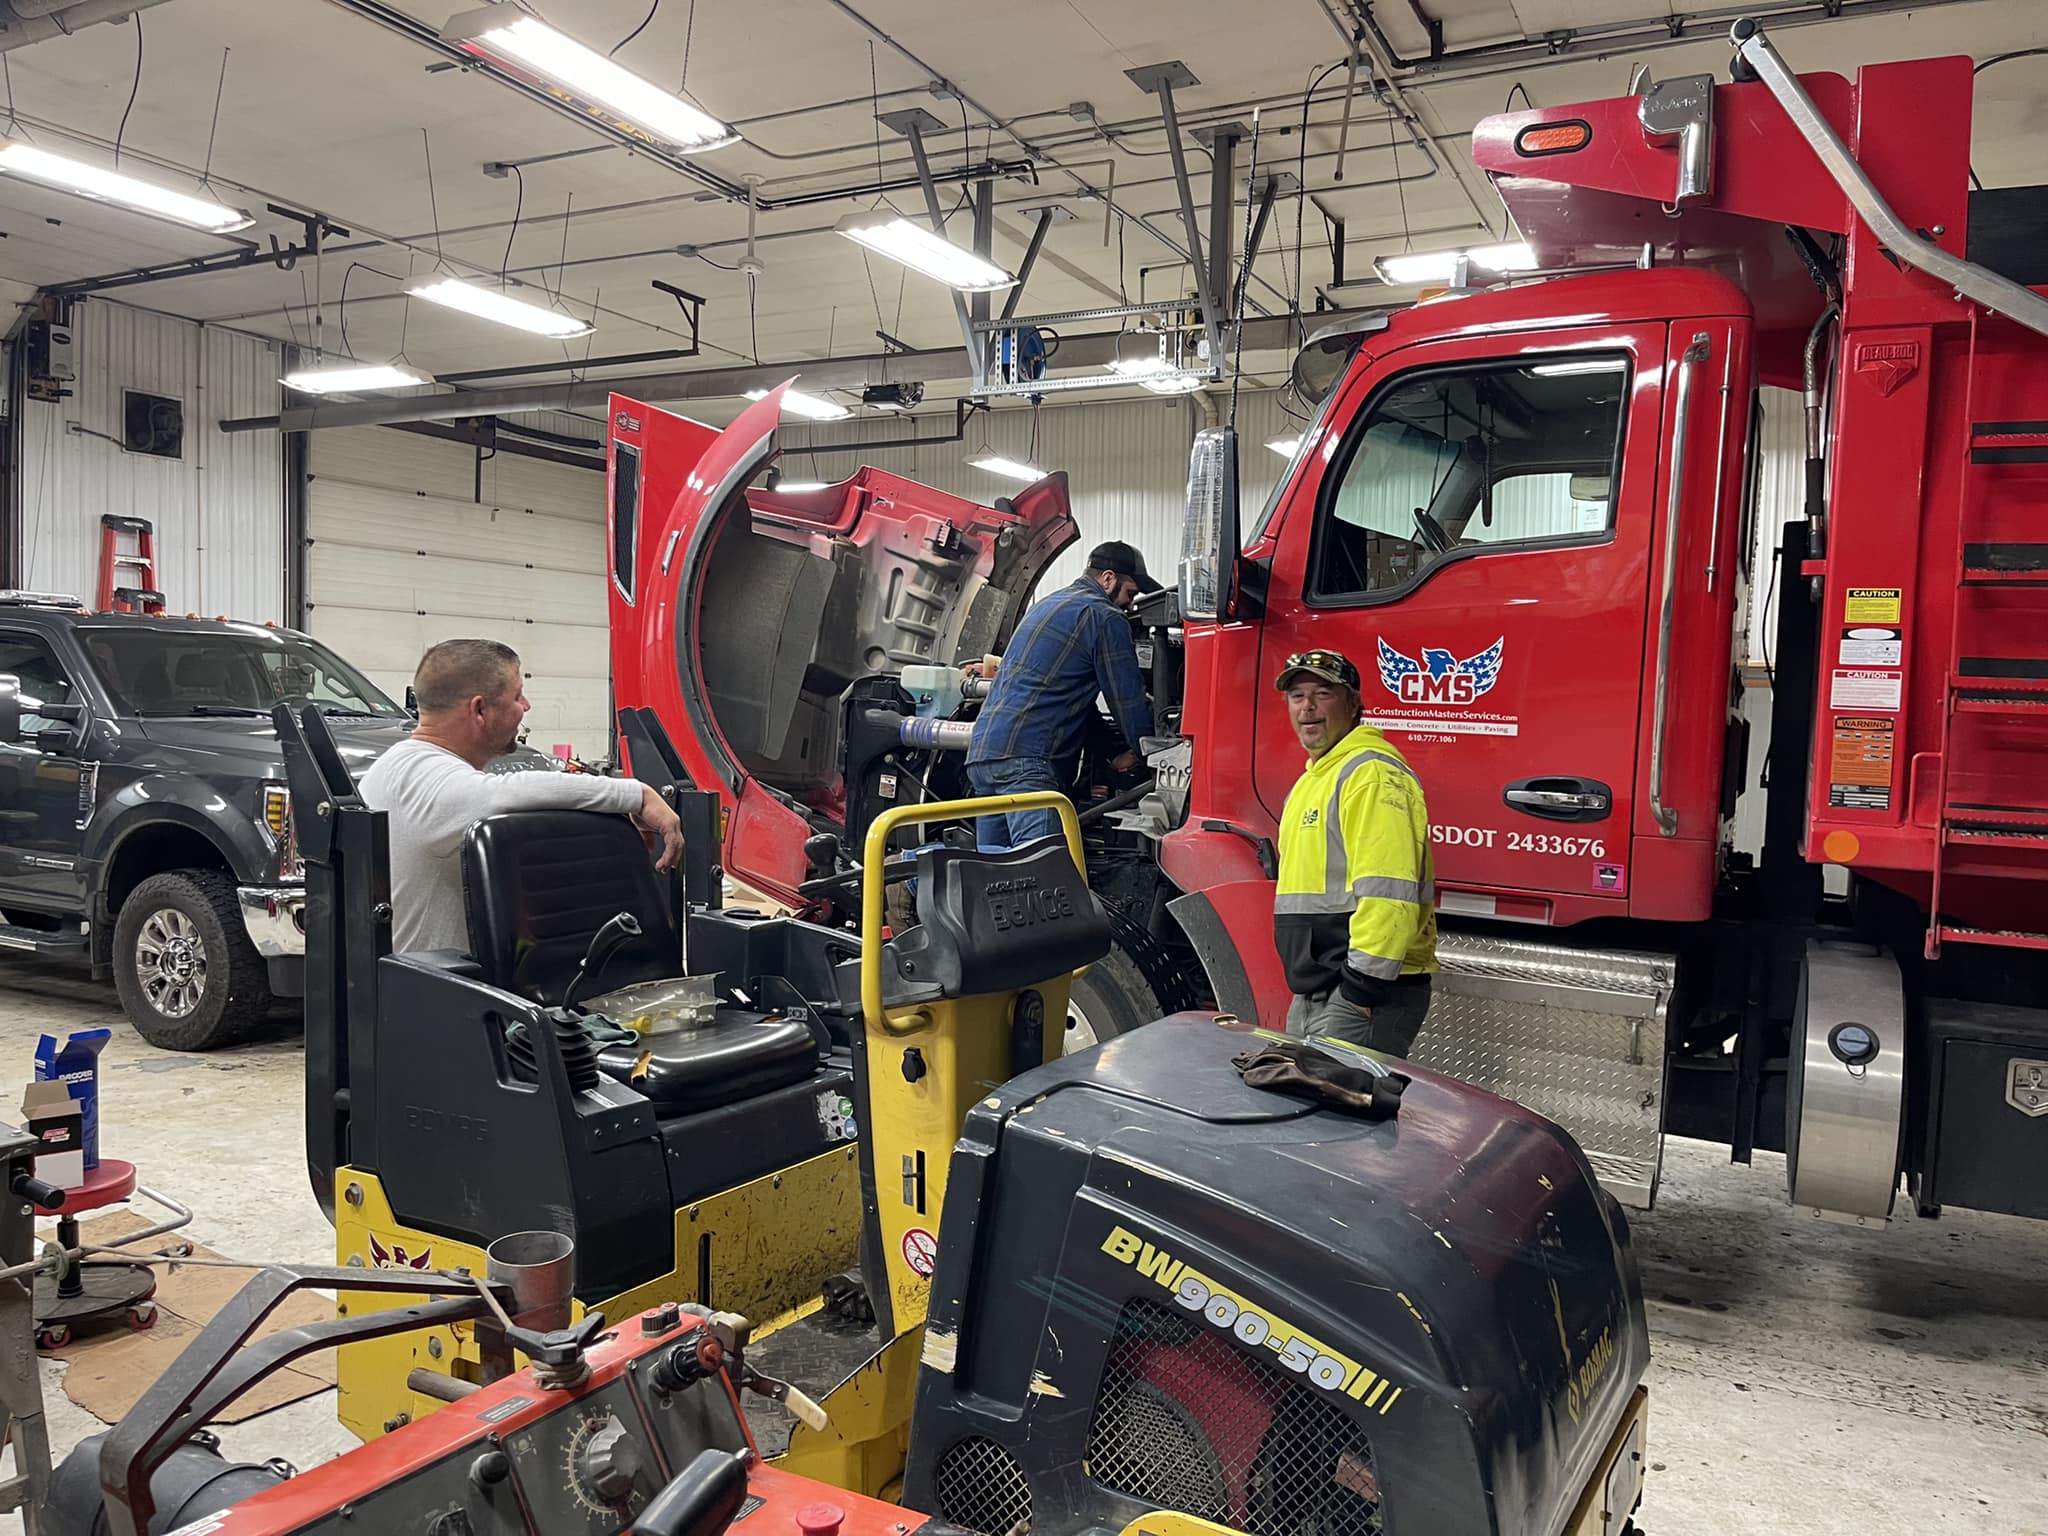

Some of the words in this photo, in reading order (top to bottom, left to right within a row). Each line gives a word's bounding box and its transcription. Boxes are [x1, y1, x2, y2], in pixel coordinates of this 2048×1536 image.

[1853, 590, 1895, 598] CAUTION
[1847, 671, 1888, 680] CAUTION
[1401, 674, 1474, 702] CMS
[1406, 721, 1440, 730] Concrete
[1447, 724, 1476, 732] Utilities
[1484, 726, 1509, 734] Paving
[1842, 720, 1887, 729] WARNING
[1407, 734, 1457, 744] 610.777.1061
[1428, 824, 1497, 848] SDOT
[1507, 832, 1606, 858] 2433676
[1579, 1326, 1613, 1400] BOMAG
